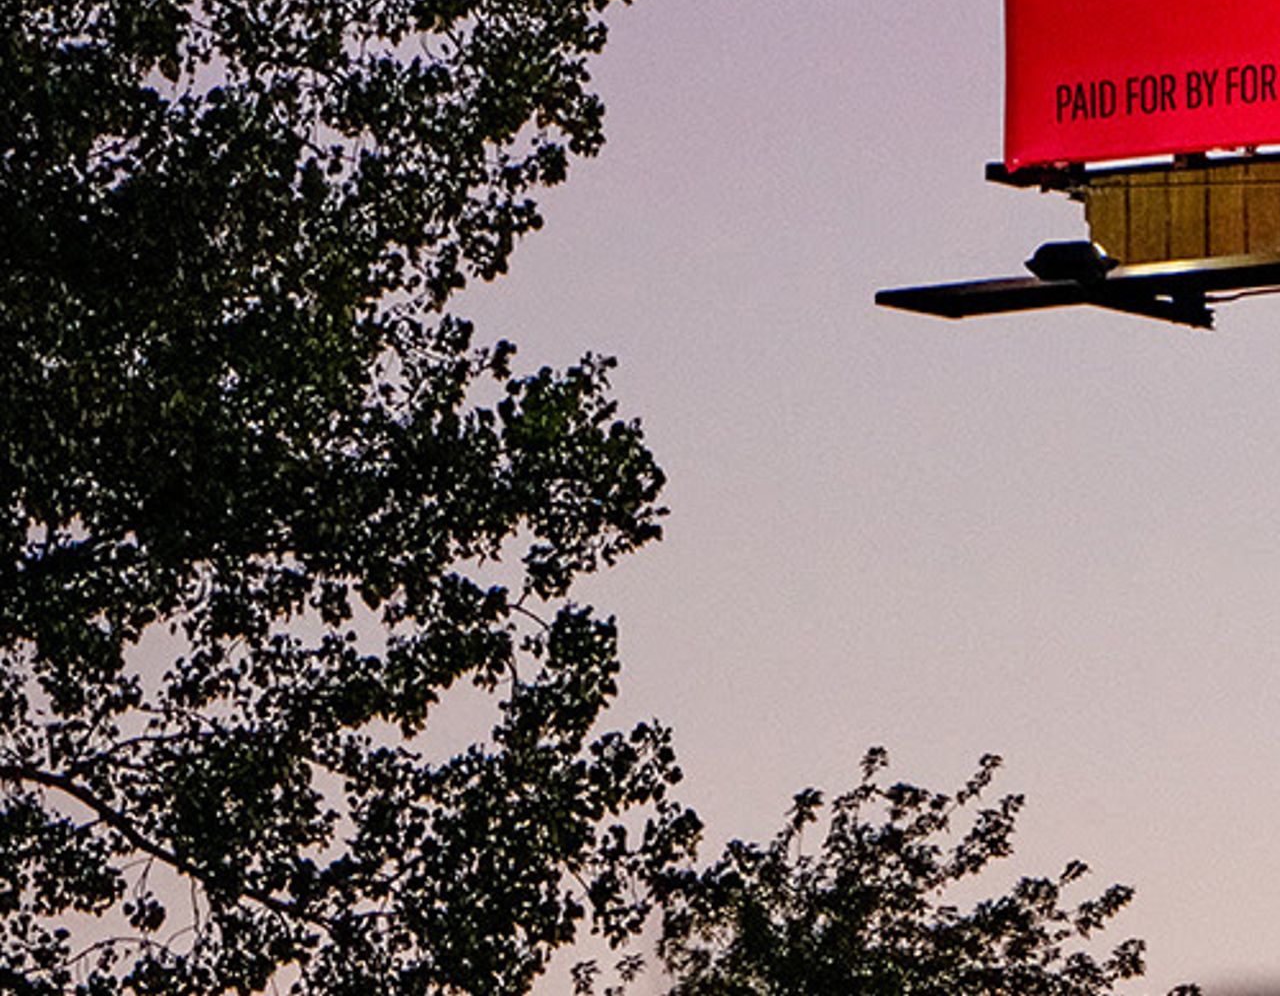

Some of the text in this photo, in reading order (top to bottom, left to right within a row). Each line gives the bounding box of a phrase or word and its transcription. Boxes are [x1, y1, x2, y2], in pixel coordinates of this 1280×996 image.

[1054, 78, 1118, 123] PAID
[1125, 72, 1178, 117] FOR
[1185, 68, 1220, 110] BY
[1225, 63, 1277, 105] FOR
